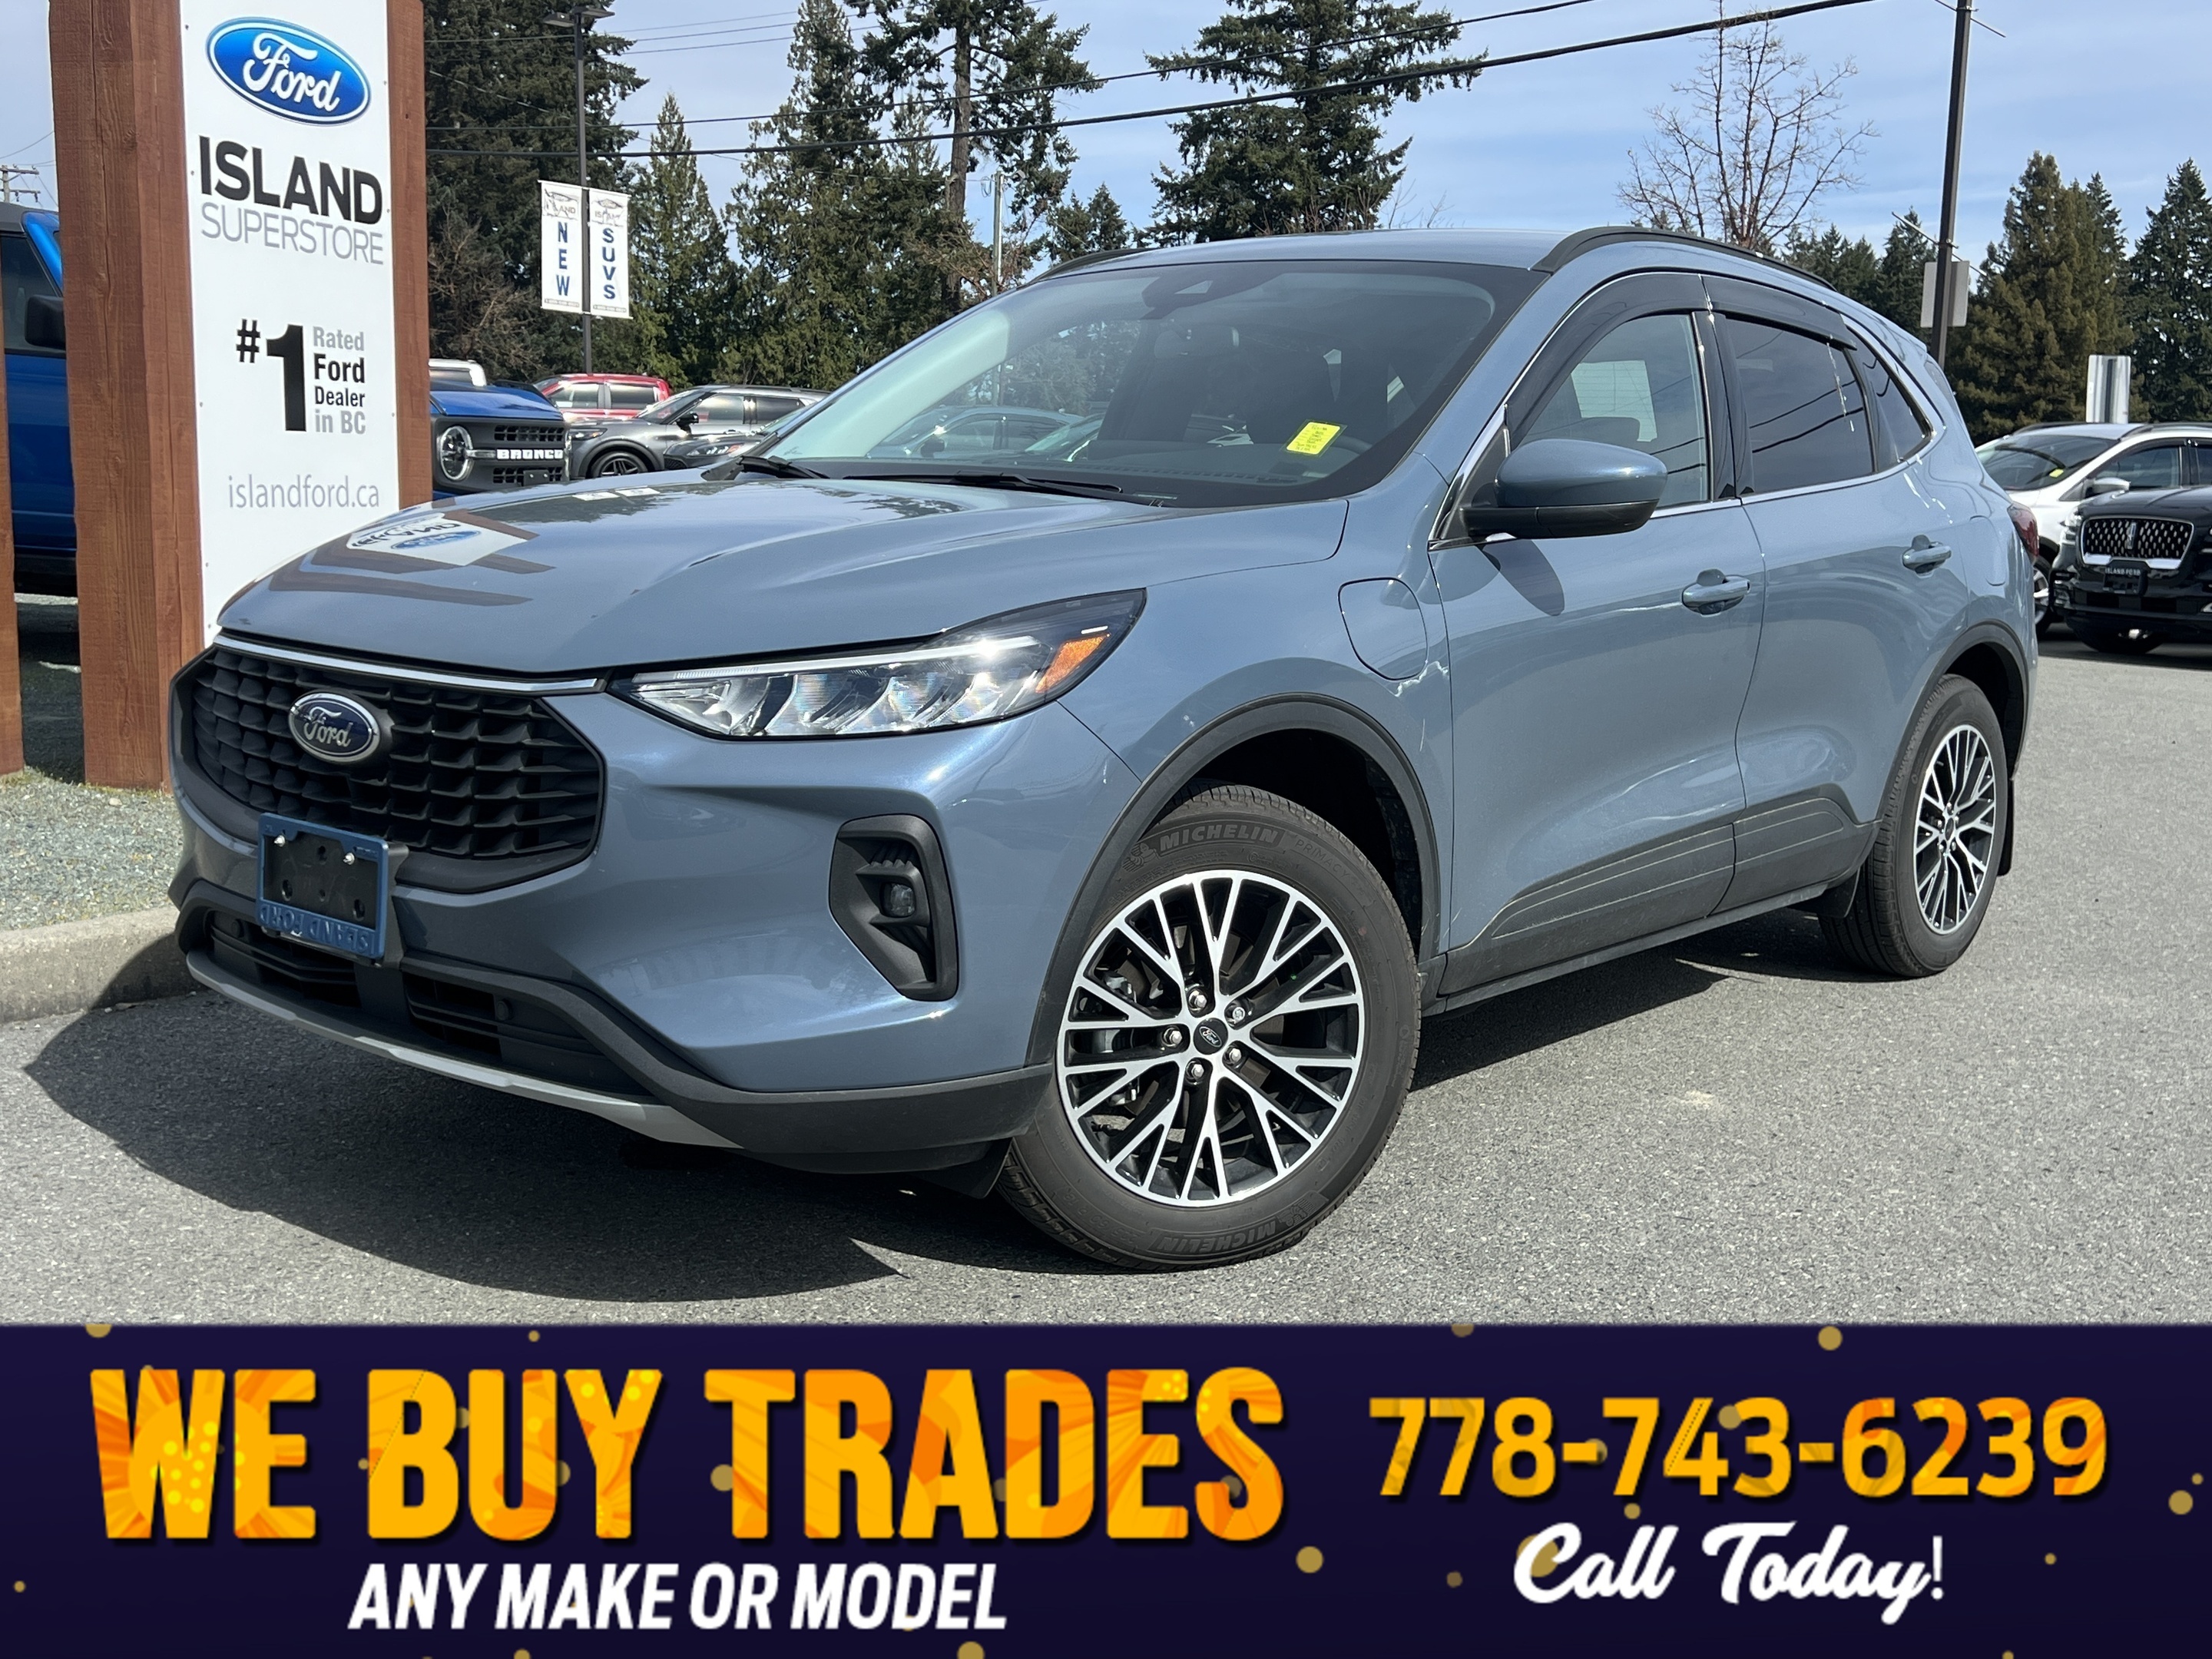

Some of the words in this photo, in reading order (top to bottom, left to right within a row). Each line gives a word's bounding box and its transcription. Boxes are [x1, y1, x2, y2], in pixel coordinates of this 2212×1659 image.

[243, 32, 342, 111] Ford
[198, 134, 382, 225] ISLAND
[200, 201, 384, 265] SUPERSTORE
[555, 221, 570, 296] NEW
[601, 227, 616, 299] SUVS
[313, 326, 364, 351] Rated
[313, 353, 365, 383] Ford
[314, 386, 365, 407] Dealer
[315, 409, 333, 432] in
[341, 410, 366, 434] BC
[496, 449, 564, 460] BRONCO
[228, 473, 379, 508] islandford.ca
[303, 706, 353, 747] Ford
[1159, 824, 1279, 853] MICHELIN
[1294, 839, 1351, 879] PRIMACY
[1157, 1220, 1277, 1253] MICHELIN
